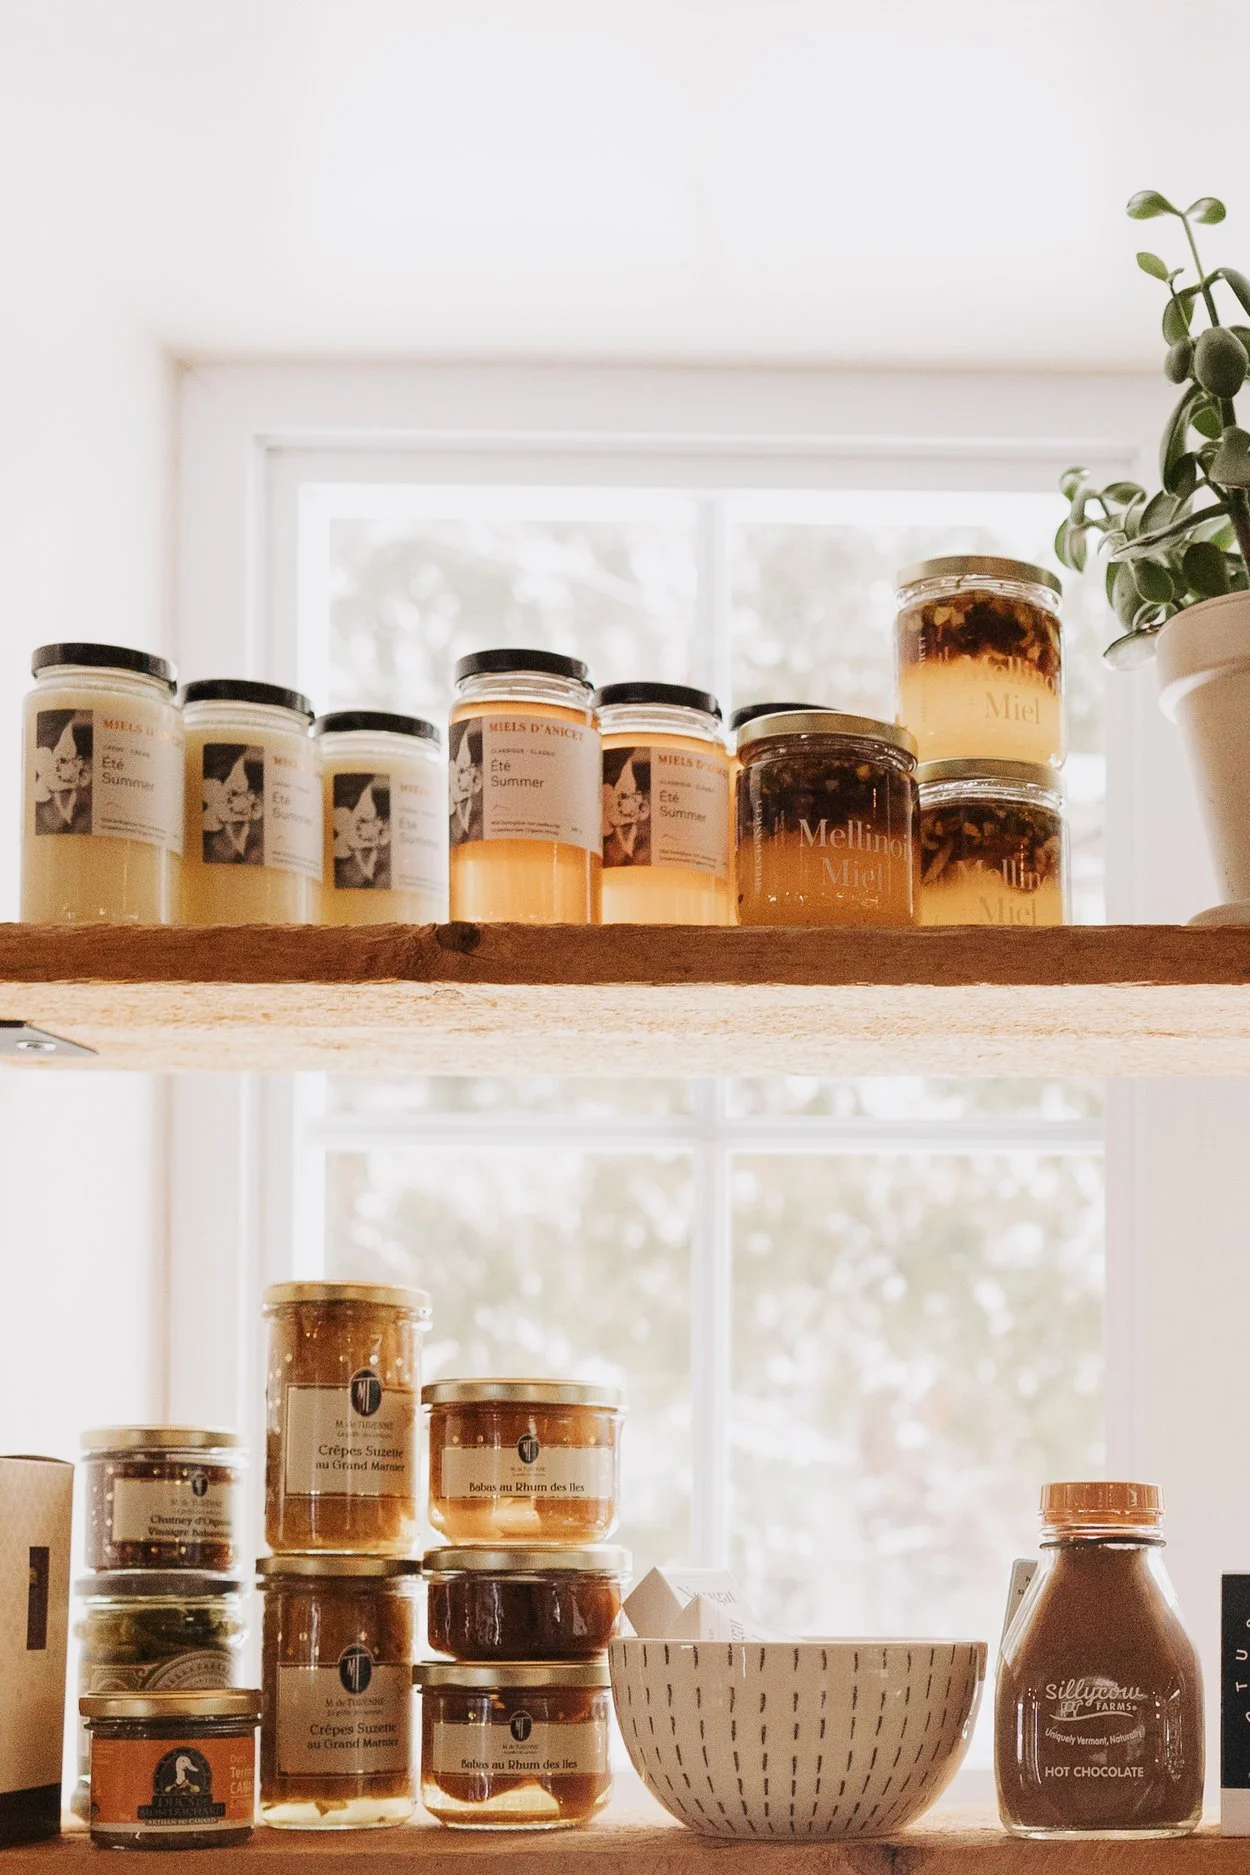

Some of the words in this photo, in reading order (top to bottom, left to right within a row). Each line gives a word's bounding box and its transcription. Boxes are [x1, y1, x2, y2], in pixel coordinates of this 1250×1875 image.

[984, 692, 1041, 725] Miel
[488, 721, 525, 733] MIELS
[530, 723, 585, 742] D'ANICET
[490, 758, 511, 773] Été
[658, 754, 694, 767] MIELS
[102, 771, 154, 791] Summer
[490, 775, 545, 789] Summer
[660, 805, 707, 823] Summer
[821, 856, 883, 891] Miel
[318, 1444, 362, 1459] Crêpes
[332, 1461, 367, 1471] Grand
[469, 1482, 497, 1492] Babas
[499, 1484, 513, 1492] au
[515, 1482, 548, 1492] Rhum
[550, 1482, 567, 1492] des
[310, 1722, 354, 1737] Crêpes
[1045, 1728, 1076, 1745] Uniquely
[1077, 1736, 1108, 1746] Vermont,
[1109, 1729, 1144, 1743] Naturally
[324, 1739, 359, 1749] Grand
[461, 1758, 489, 1770] Babas
[491, 1760, 505, 1770] au
[508, 1759, 540, 1770] Rhum
[543, 1758, 560, 1770] des
[1045, 1767, 1070, 1778] HOT
[1073, 1767, 1144, 1778] CHOCOLATE
